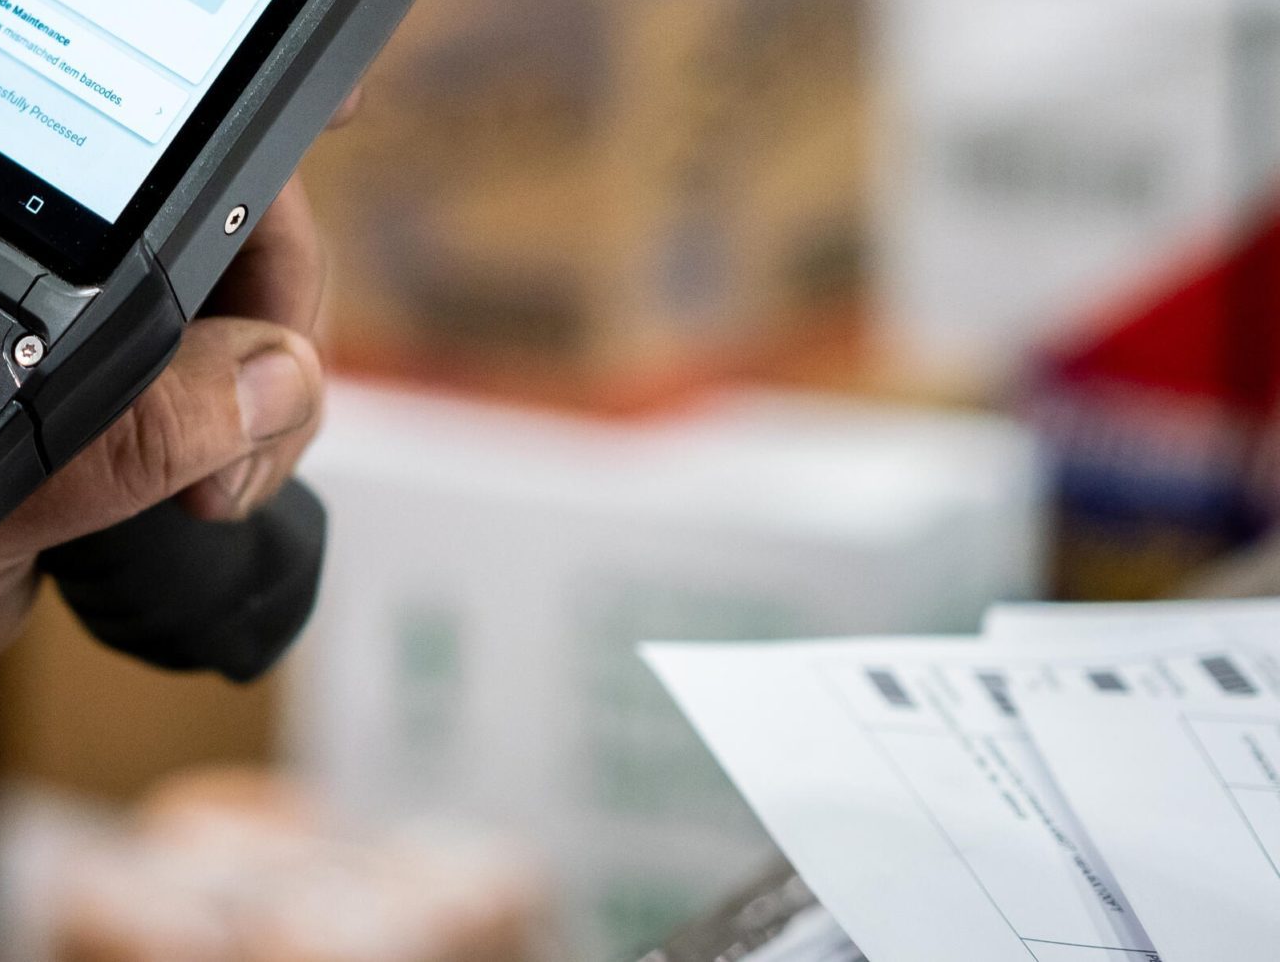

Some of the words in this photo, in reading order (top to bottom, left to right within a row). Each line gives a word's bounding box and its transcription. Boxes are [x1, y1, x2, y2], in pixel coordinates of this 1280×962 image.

[11, 5, 71, 47] Maintenance
[3, 27, 61, 66] mismatched
[58, 61, 80, 79] item
[79, 72, 125, 108] barcodes.
[29, 105, 88, 147] Processed
